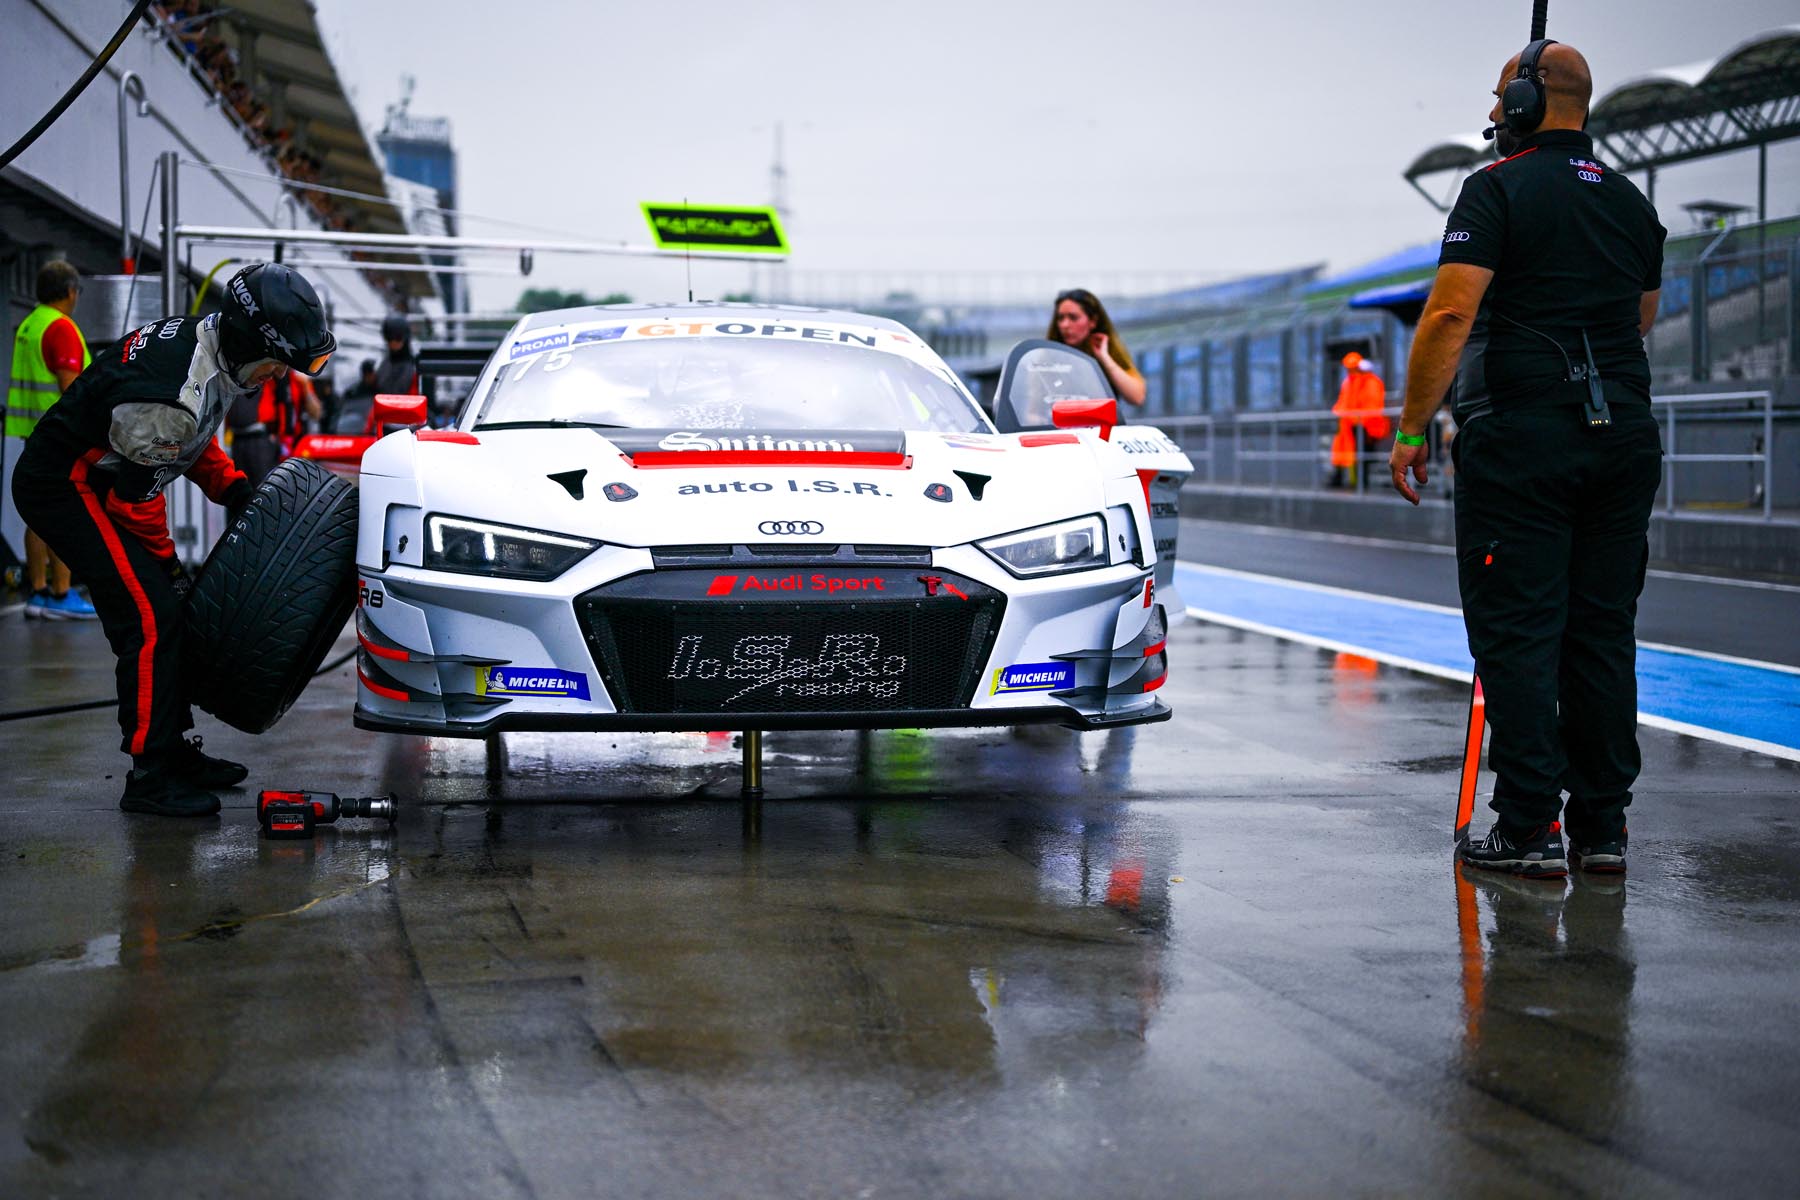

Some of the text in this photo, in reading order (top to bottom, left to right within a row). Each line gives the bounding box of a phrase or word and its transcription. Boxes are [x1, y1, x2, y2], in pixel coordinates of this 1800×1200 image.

[233, 275, 260, 317] uvex
[511, 335, 567, 356] PROAM
[513, 346, 576, 382] 75
[678, 480, 893, 497] auto I.S.R.
[743, 574, 885, 594] Audi Sport
[508, 677, 578, 690] MICHELIN
[1009, 671, 1067, 684] MICHELIN
